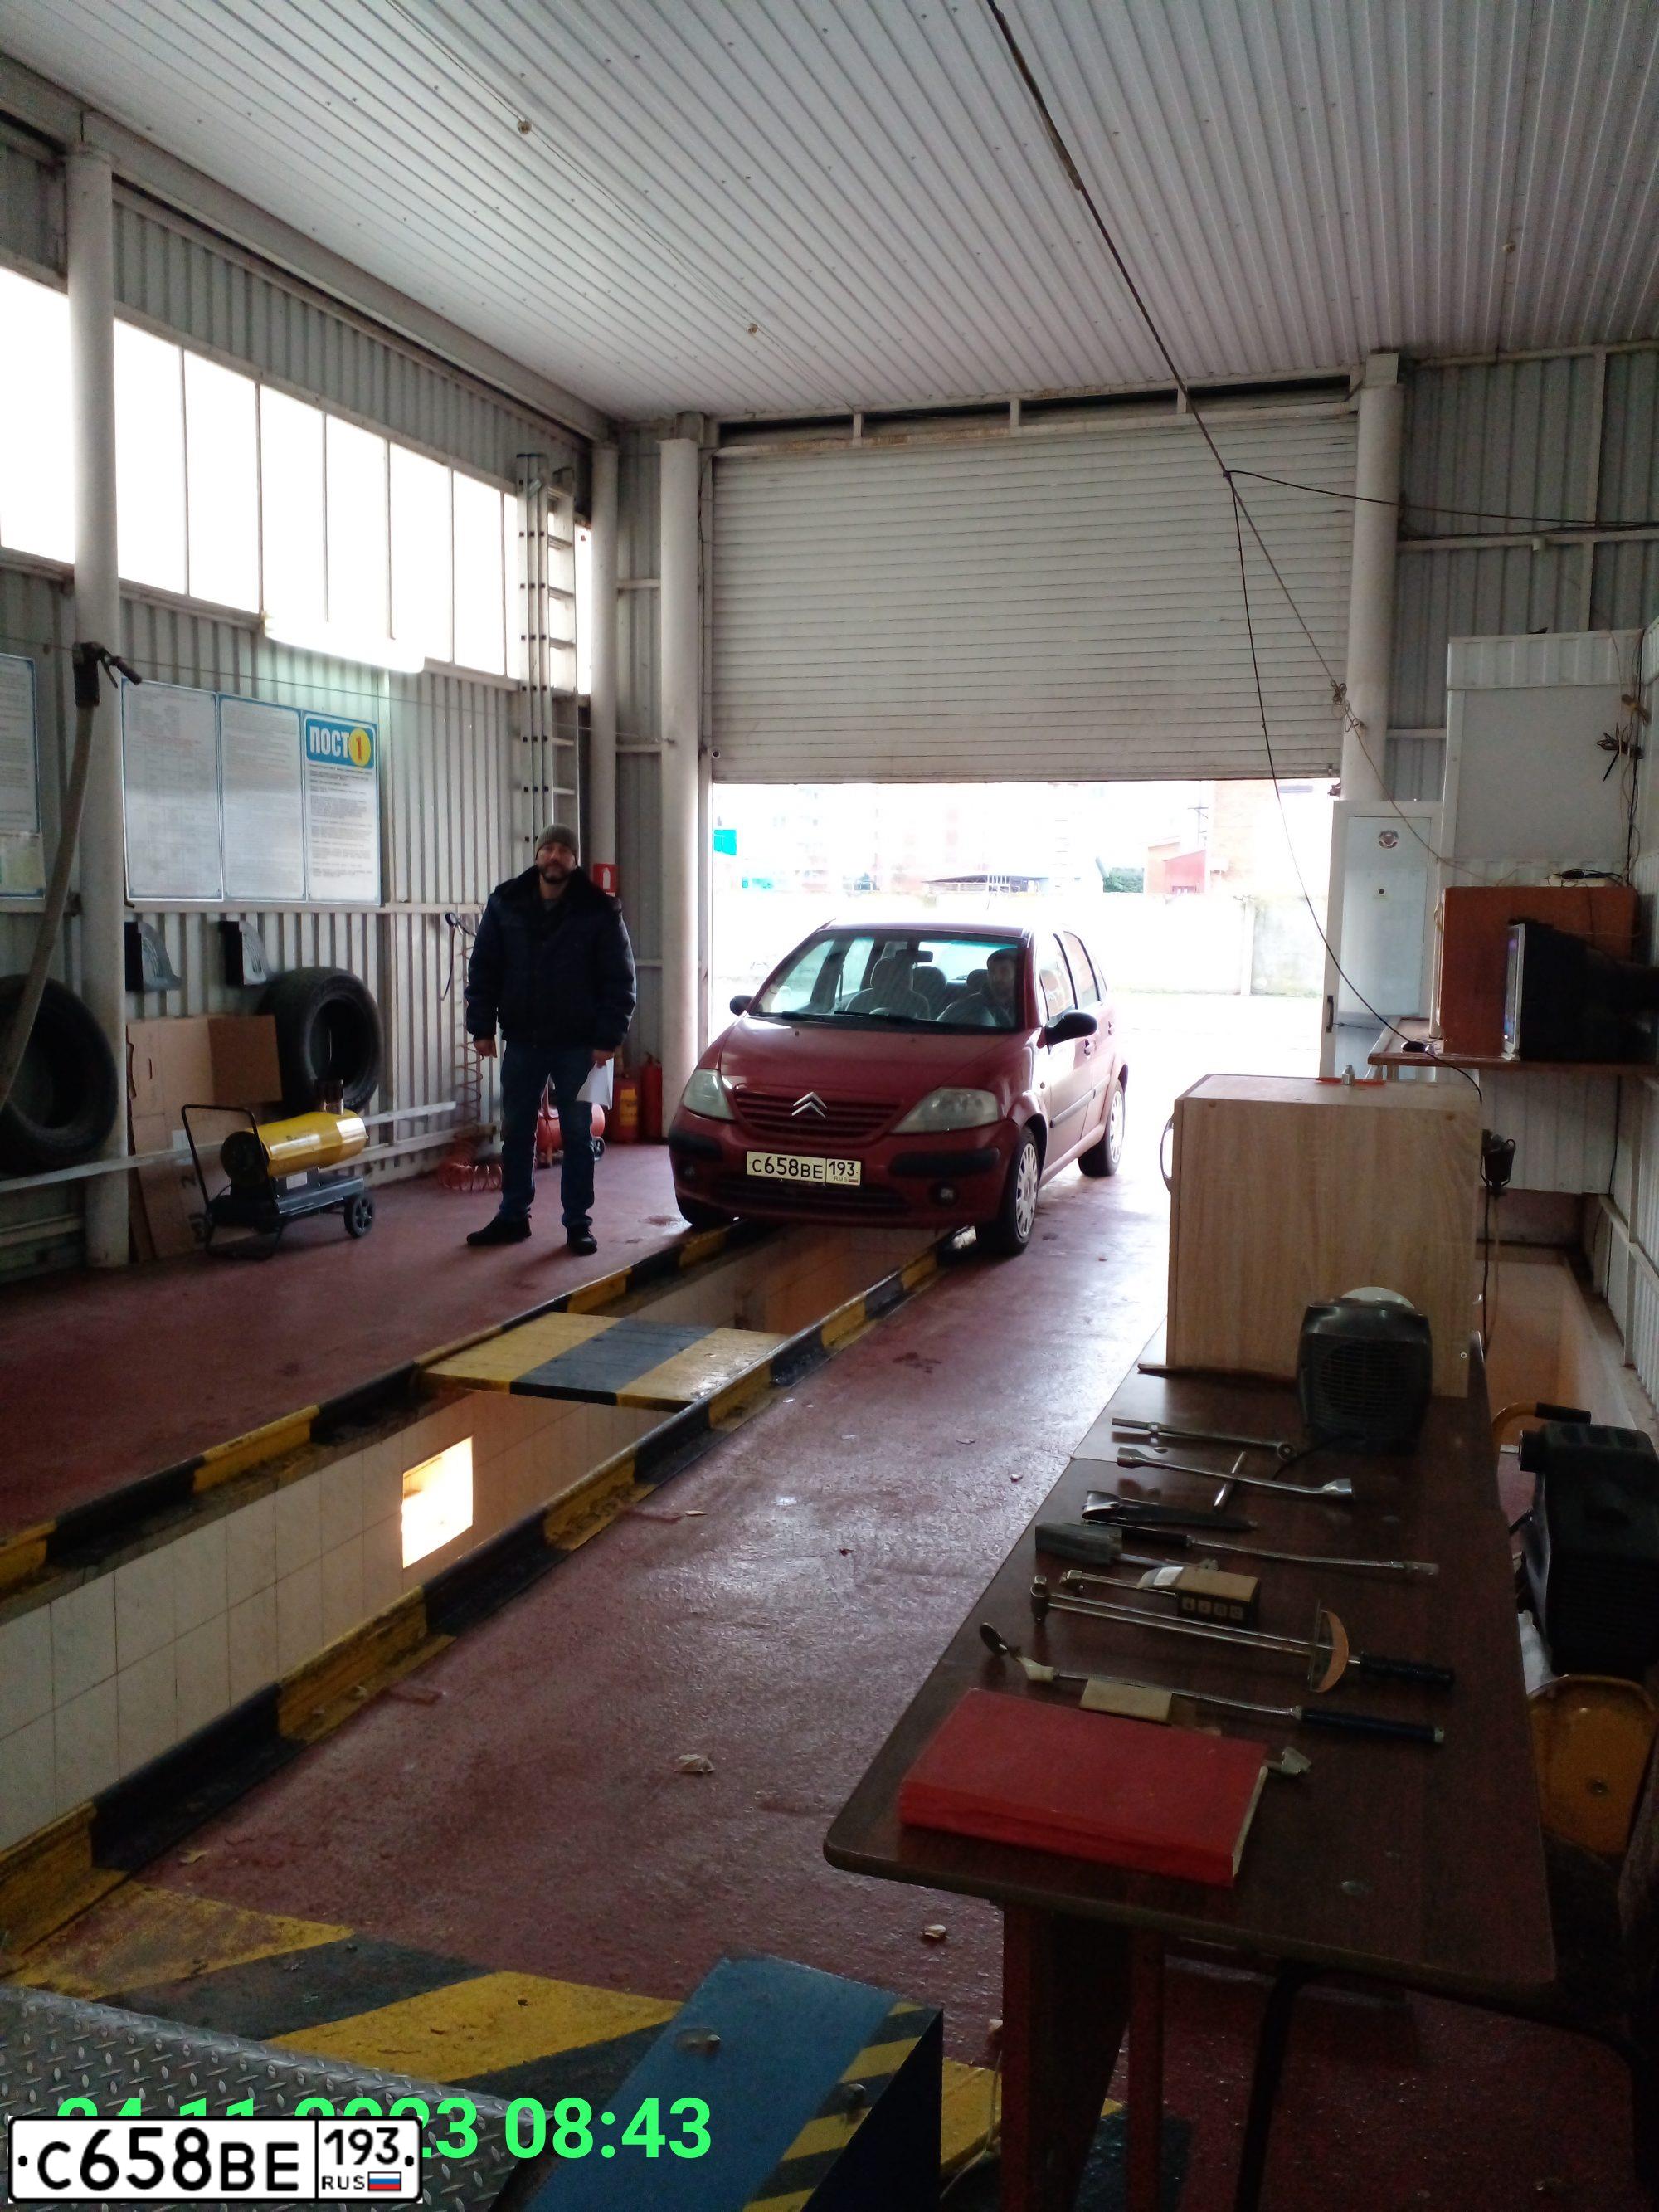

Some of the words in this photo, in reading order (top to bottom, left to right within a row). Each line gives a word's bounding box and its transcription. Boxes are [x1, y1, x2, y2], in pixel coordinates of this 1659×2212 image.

[309, 725, 349, 759] ПОСТ
[752, 1156, 824, 1180] С658ВЕ
[829, 1161, 855, 1177] 193
